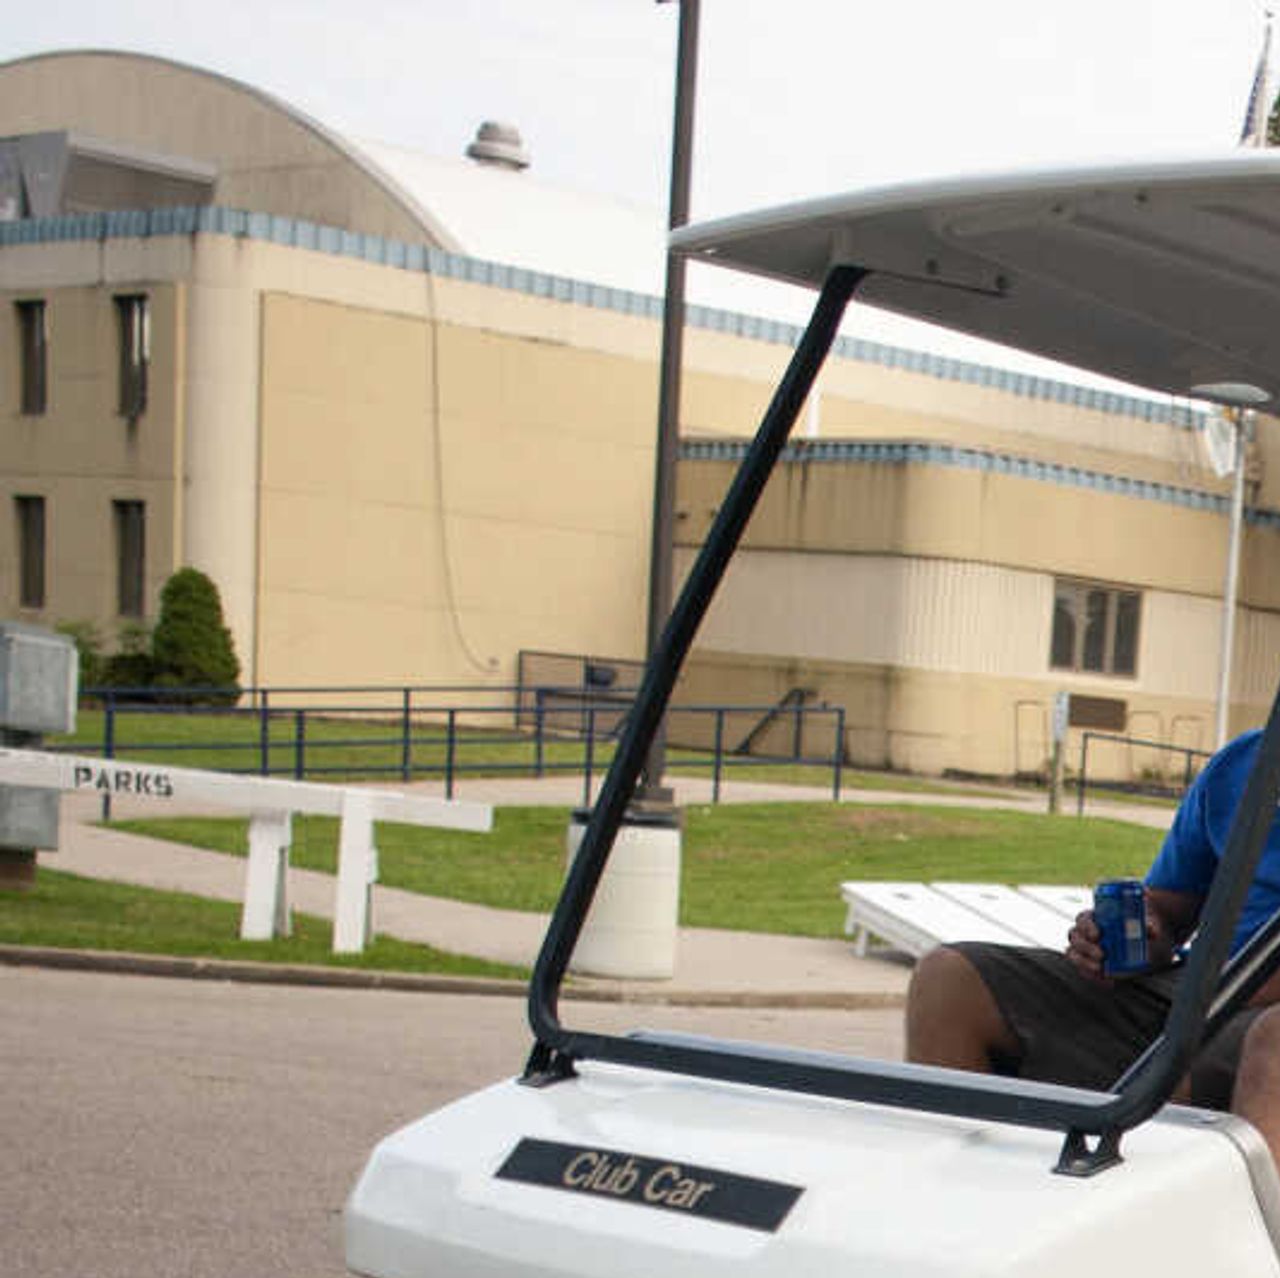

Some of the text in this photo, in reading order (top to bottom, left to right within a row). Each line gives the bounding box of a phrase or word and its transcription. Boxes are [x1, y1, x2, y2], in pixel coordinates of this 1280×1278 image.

[74, 767, 173, 797] PARKS
[562, 1150, 715, 1208] Club Car
